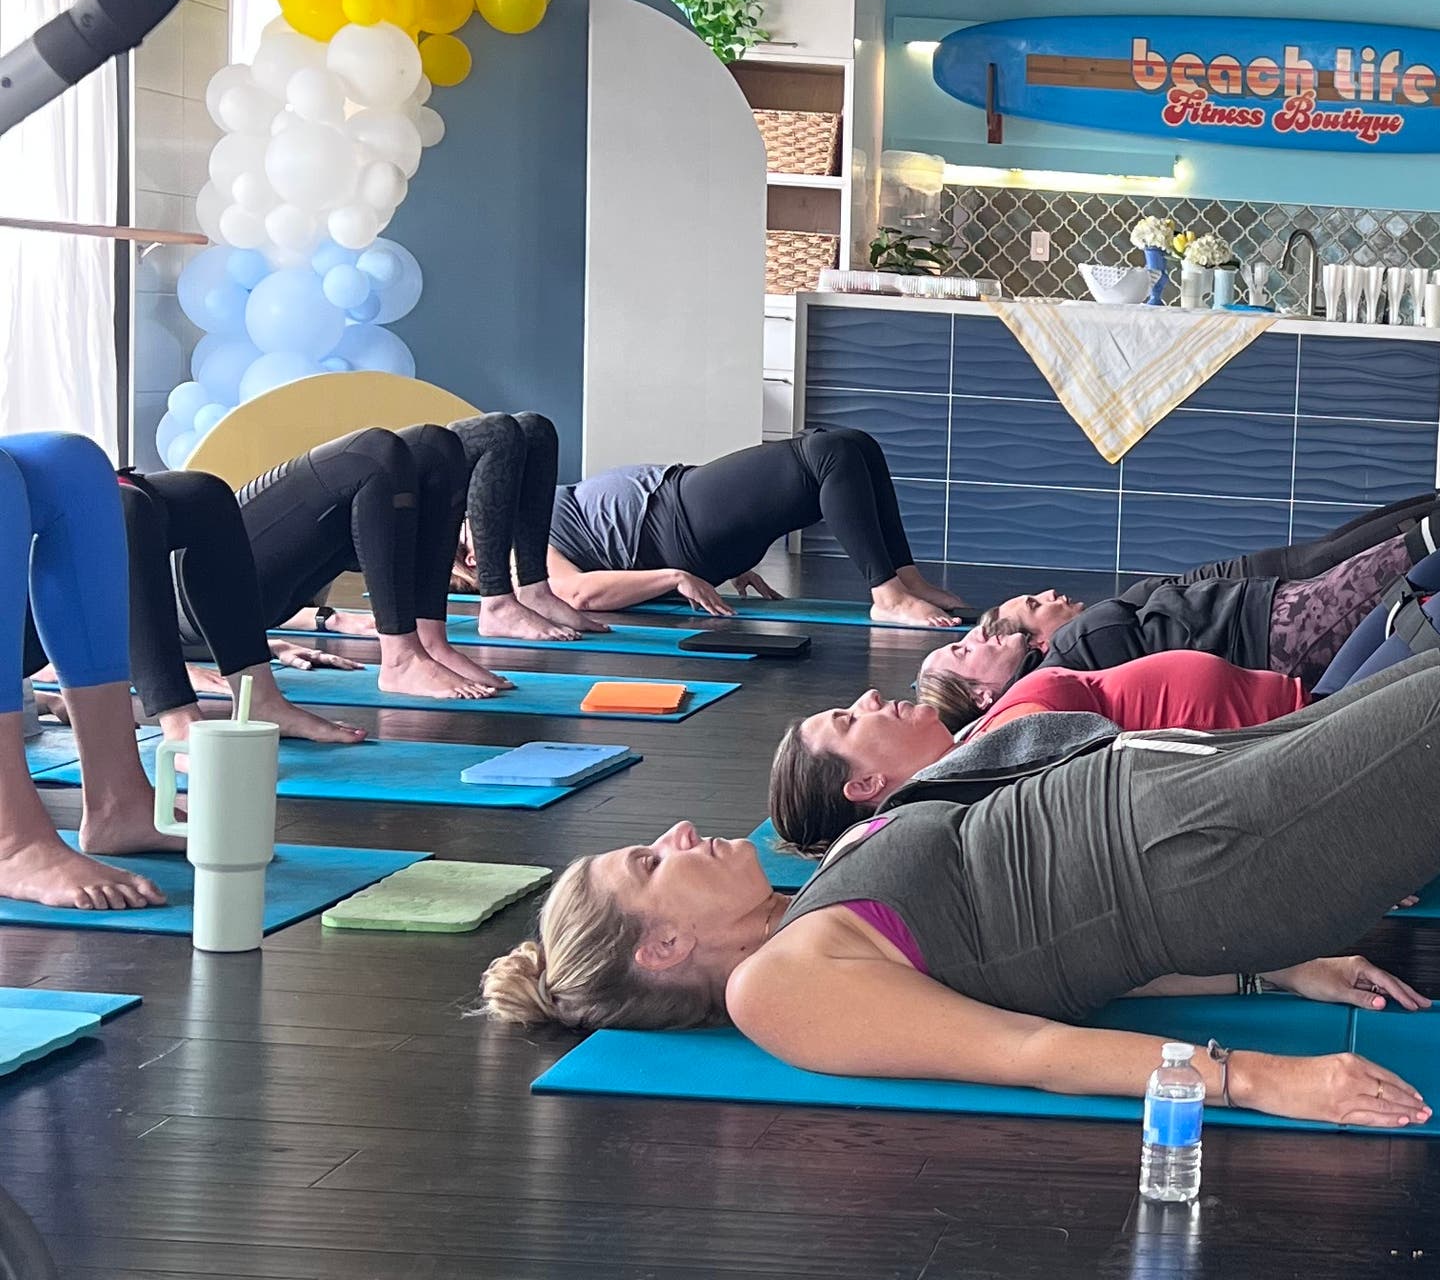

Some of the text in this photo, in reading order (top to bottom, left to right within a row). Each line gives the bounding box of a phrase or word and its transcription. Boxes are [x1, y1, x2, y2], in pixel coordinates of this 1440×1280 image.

[1131, 37, 1437, 104] beach life
[1163, 87, 1403, 143] Fitness Boutique
